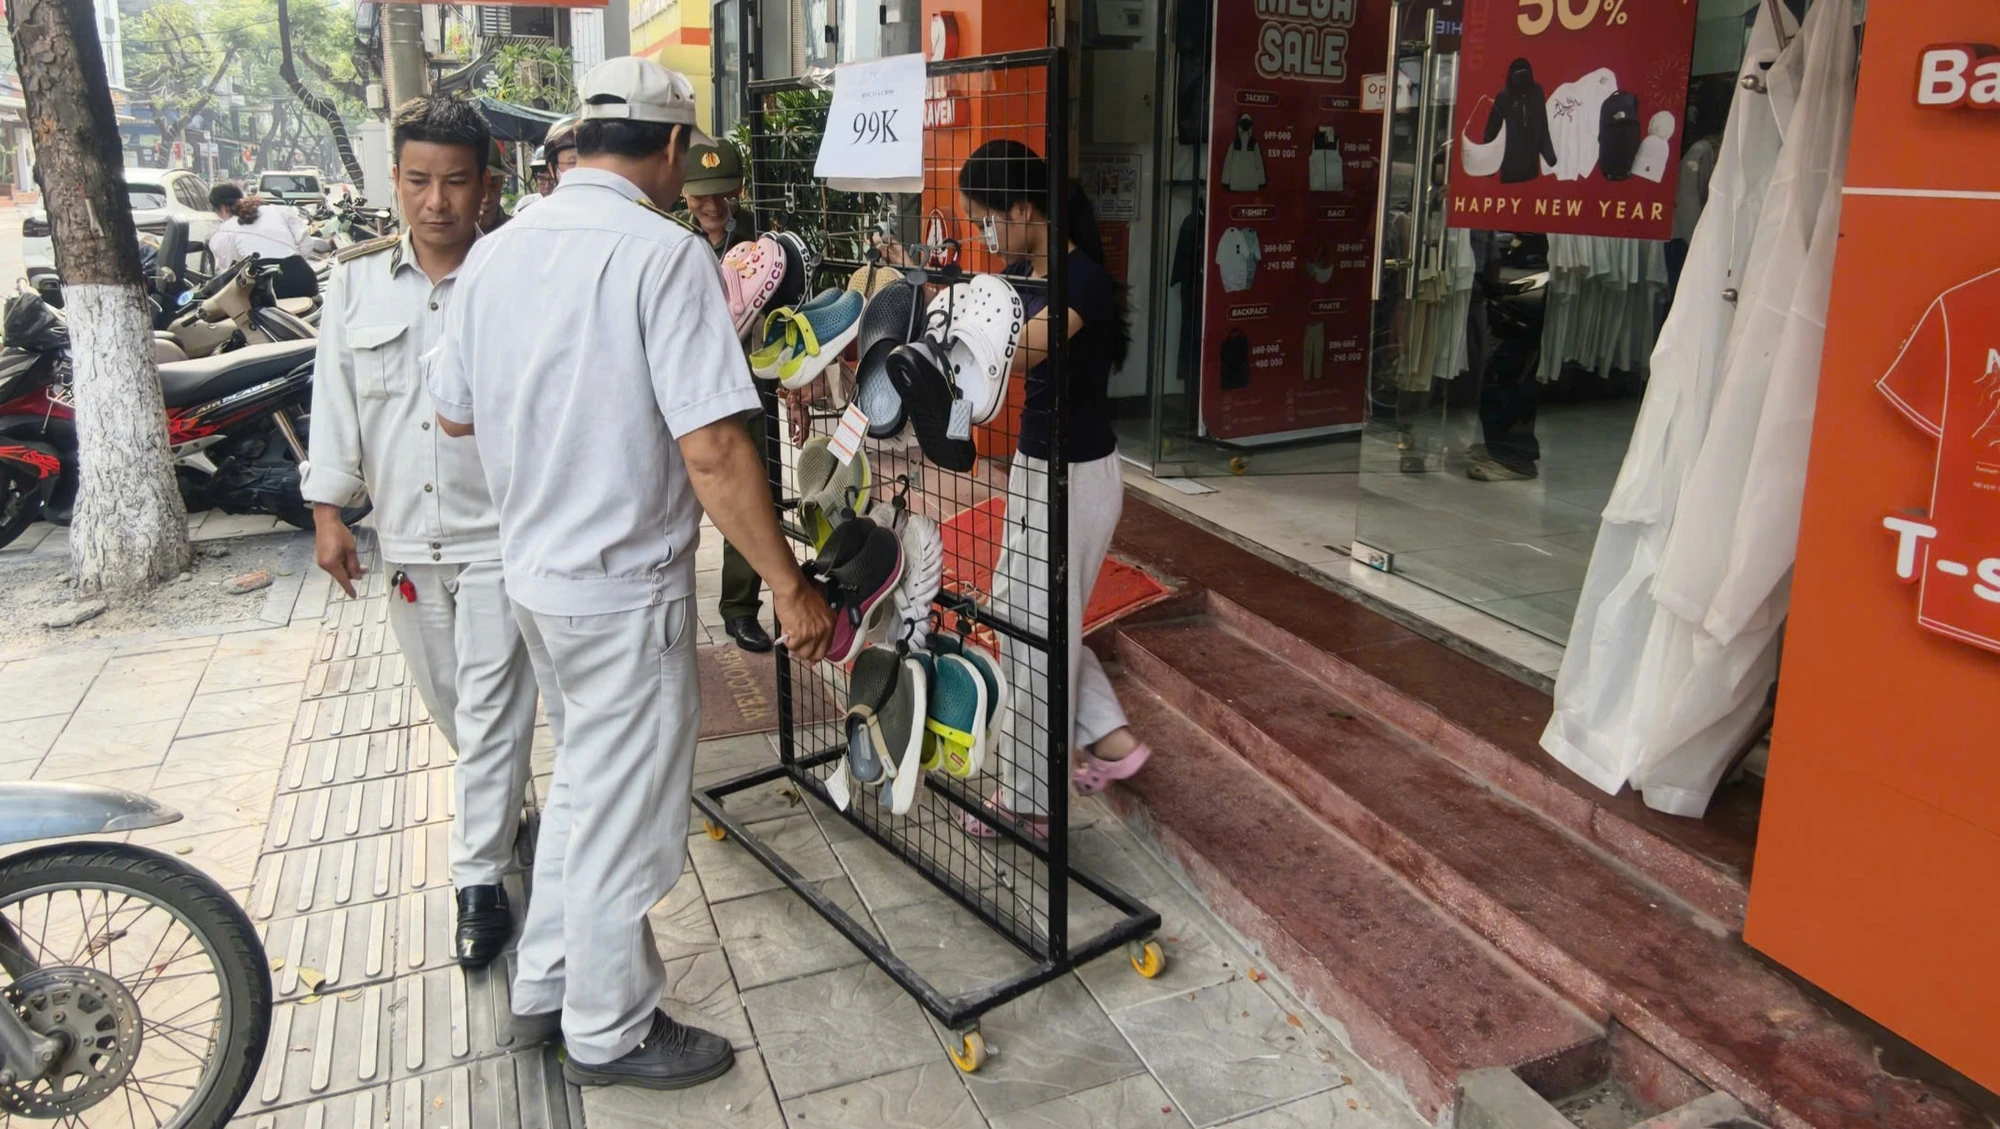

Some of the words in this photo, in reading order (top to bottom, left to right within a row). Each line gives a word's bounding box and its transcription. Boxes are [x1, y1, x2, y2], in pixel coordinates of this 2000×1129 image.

[1260, 28, 1345, 77] SALE
[924, 98, 956, 128] AVEN
[1244, 94, 1270, 103] JACKET
[851, 109, 899, 145] 99K
[1454, 196, 1522, 215] HAPPY
[1535, 198, 1584, 217] NEW
[1598, 200, 1664, 221] YEAR
[753, 261, 783, 309] crocs
[1005, 296, 1022, 359] crocs
[1231, 306, 1268, 317] BACKPACK
[713, 649, 771, 723] WELCOME
